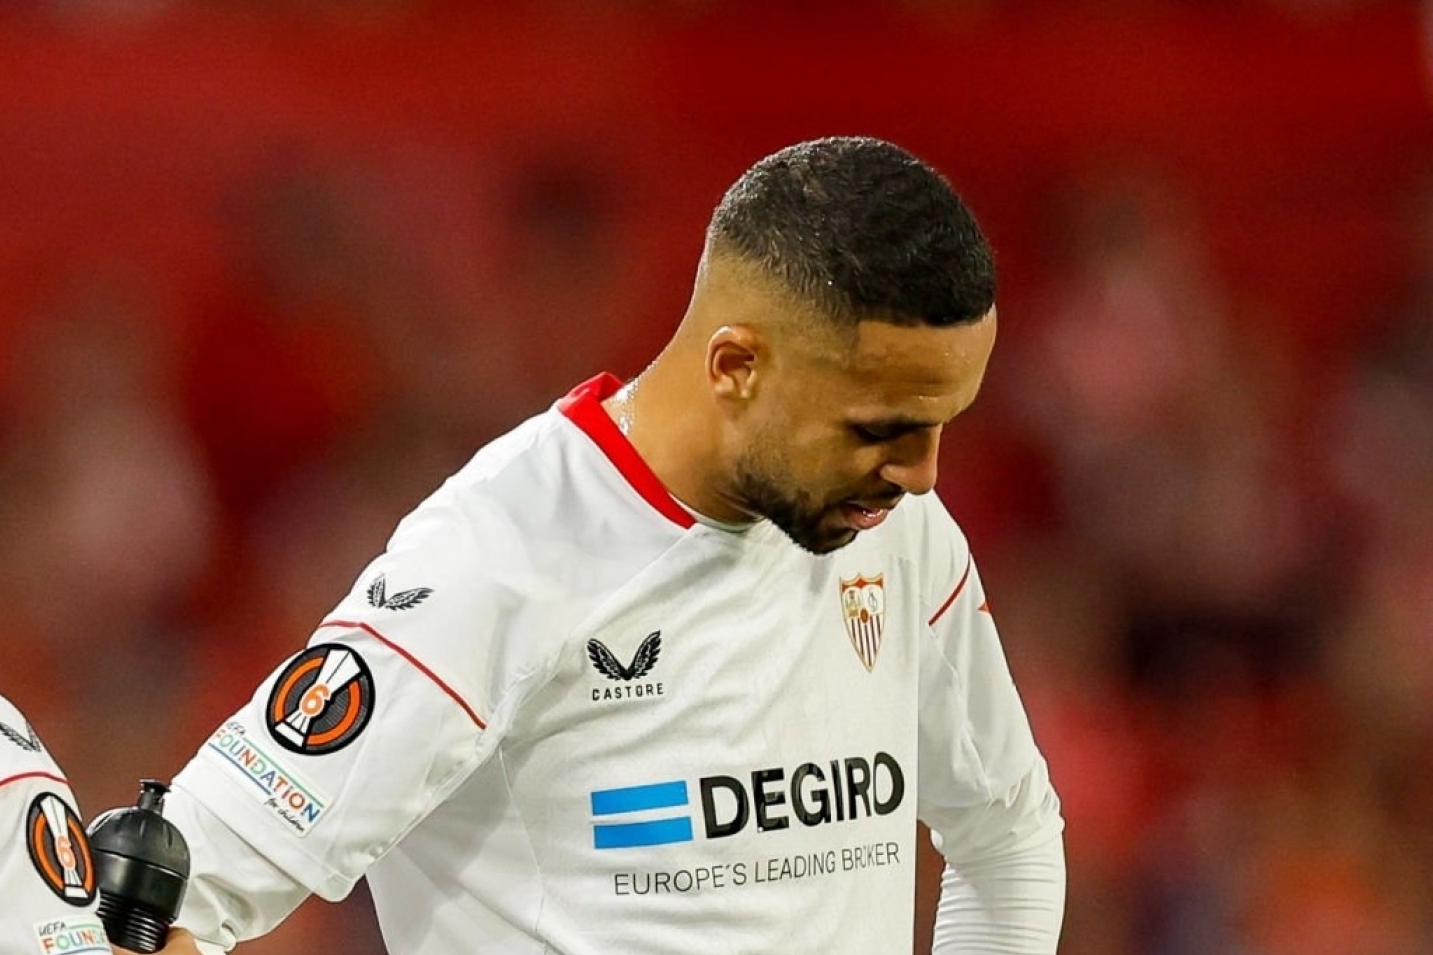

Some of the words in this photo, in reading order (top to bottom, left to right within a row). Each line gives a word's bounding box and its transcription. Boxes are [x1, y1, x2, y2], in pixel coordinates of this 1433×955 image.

[592, 683, 664, 701] CASTORE
[699, 751, 905, 839] DEGIRO
[754, 851, 836, 883] LEADING
